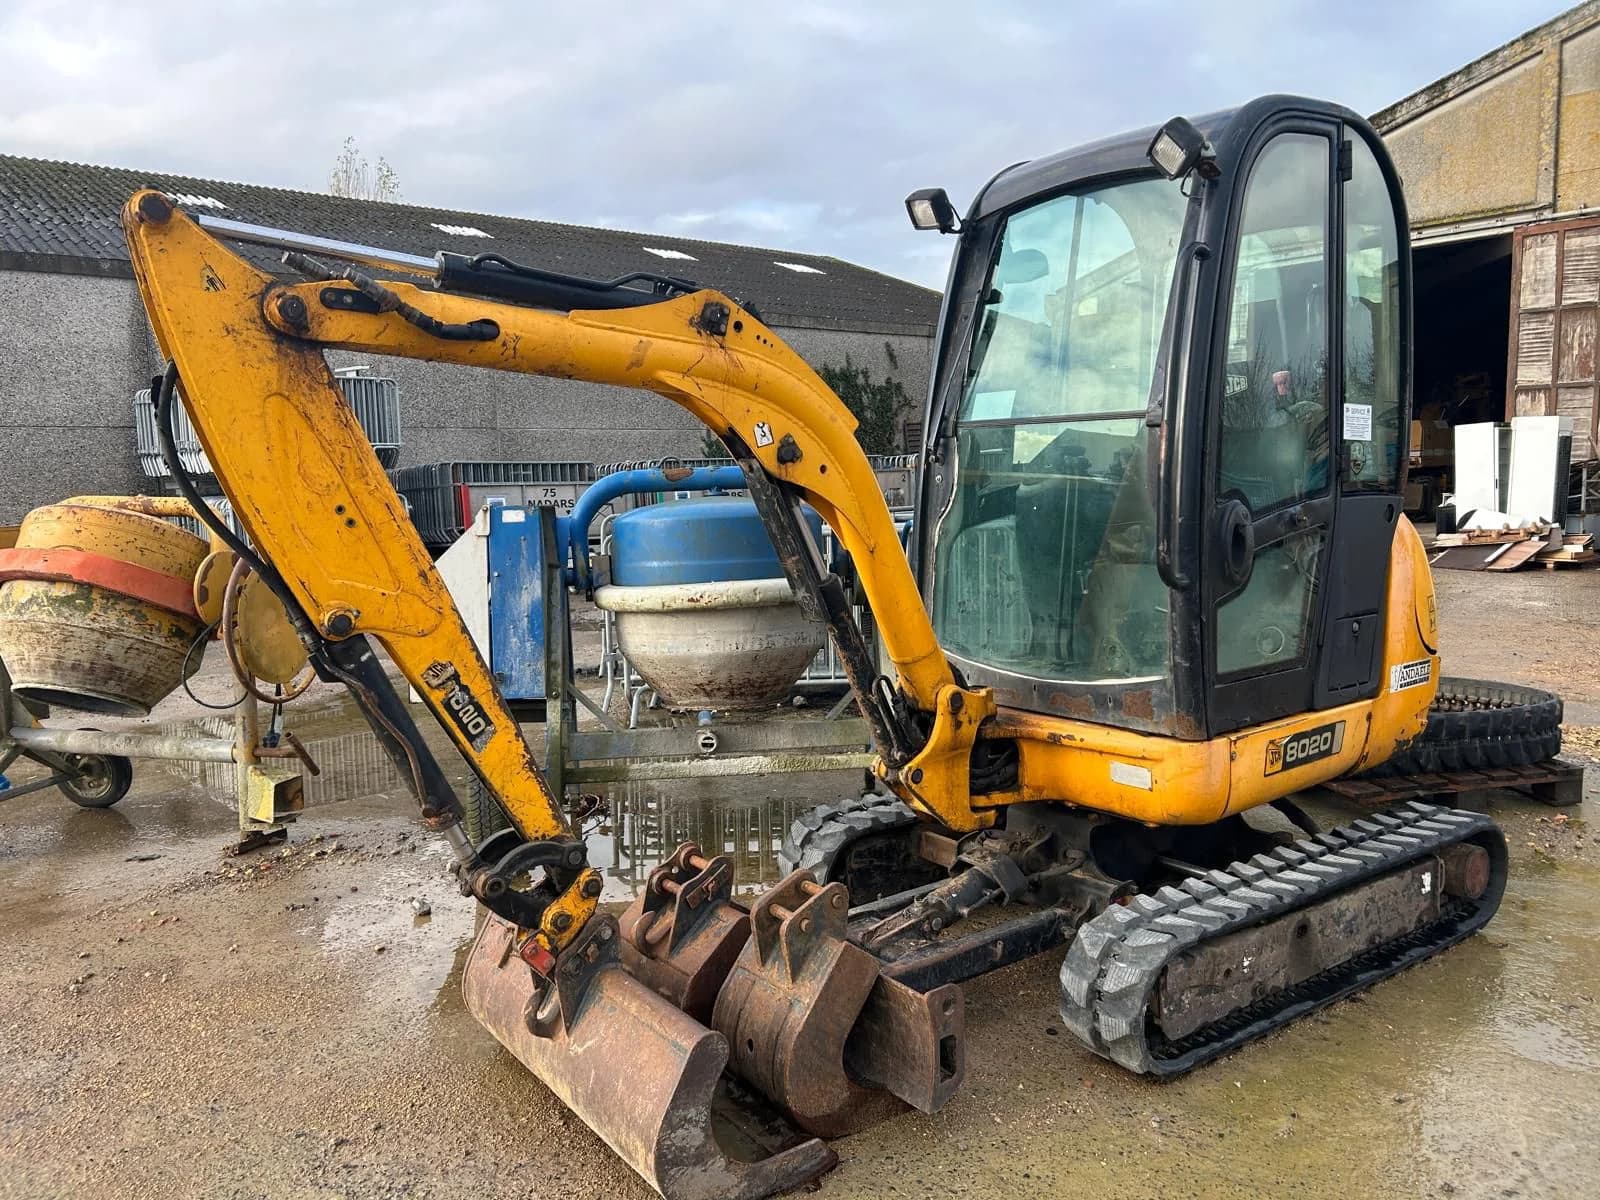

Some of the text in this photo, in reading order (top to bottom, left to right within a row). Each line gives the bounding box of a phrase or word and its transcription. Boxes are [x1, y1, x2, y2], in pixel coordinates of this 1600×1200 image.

[1225, 376, 1246, 394] JCB
[542, 488, 557, 498] 75
[1285, 731, 1332, 763] 8020
[1270, 750, 1281, 766] JCB
